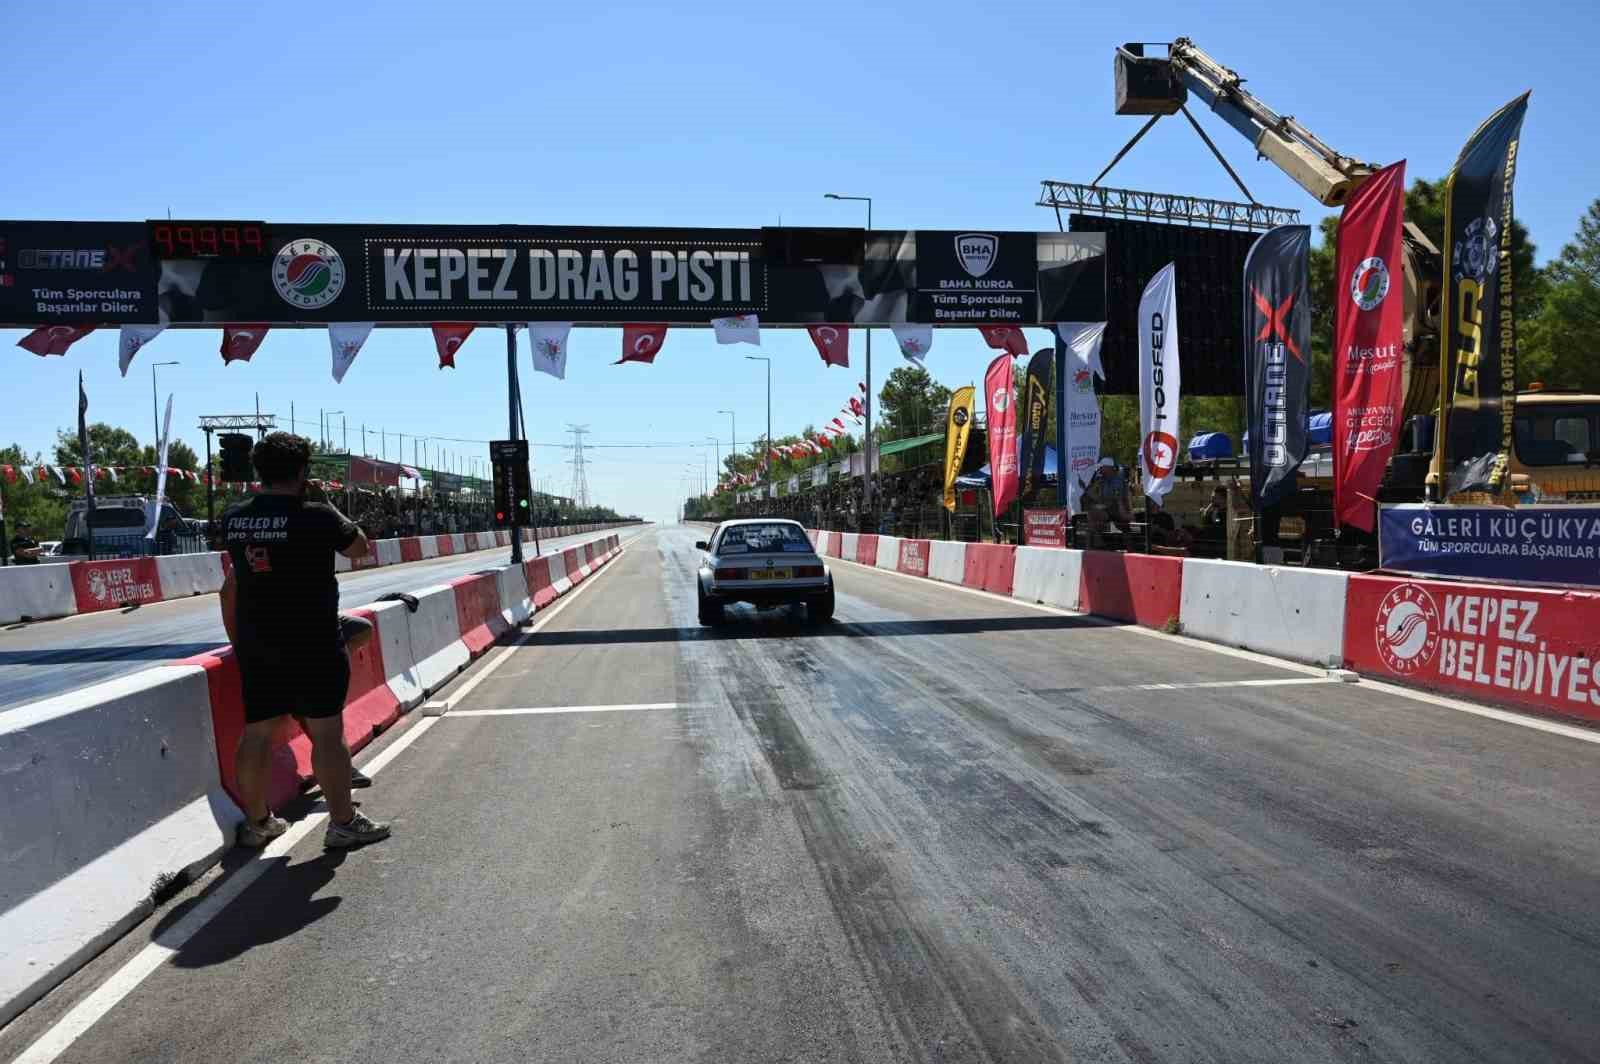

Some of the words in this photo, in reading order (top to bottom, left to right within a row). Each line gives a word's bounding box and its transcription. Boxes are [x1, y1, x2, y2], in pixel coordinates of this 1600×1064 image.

[962, 244, 991, 255] BHA
[384, 248, 518, 300] KEPEZ
[529, 249, 639, 301] DRAG
[1500, 252, 1512, 293] RALLY
[940, 280, 971, 289] BAHA
[32, 288, 63, 299] Tüm
[67, 288, 141, 301] Sporculara
[932, 294, 958, 304] Tüm
[961, 294, 1023, 305] Sporculara
[36, 302, 97, 314] Başarılar
[101, 302, 138, 312] Diler.
[935, 309, 987, 320] Başarılar
[990, 309, 1020, 318] Diler.
[1501, 311, 1514, 378] OFF-ROAD
[228, 517, 270, 529] FUELED
[273, 516, 288, 529] BY
[1411, 513, 1480, 535] GALERİ
[1418, 538, 1438, 552] TÜM
[1442, 542, 1518, 555] SPORCULARA
[1521, 546, 1594, 560] BAŞARILAR
[1382, 588, 1435, 620] KEPEZ
[1443, 594, 1539, 643] KEPEZ
